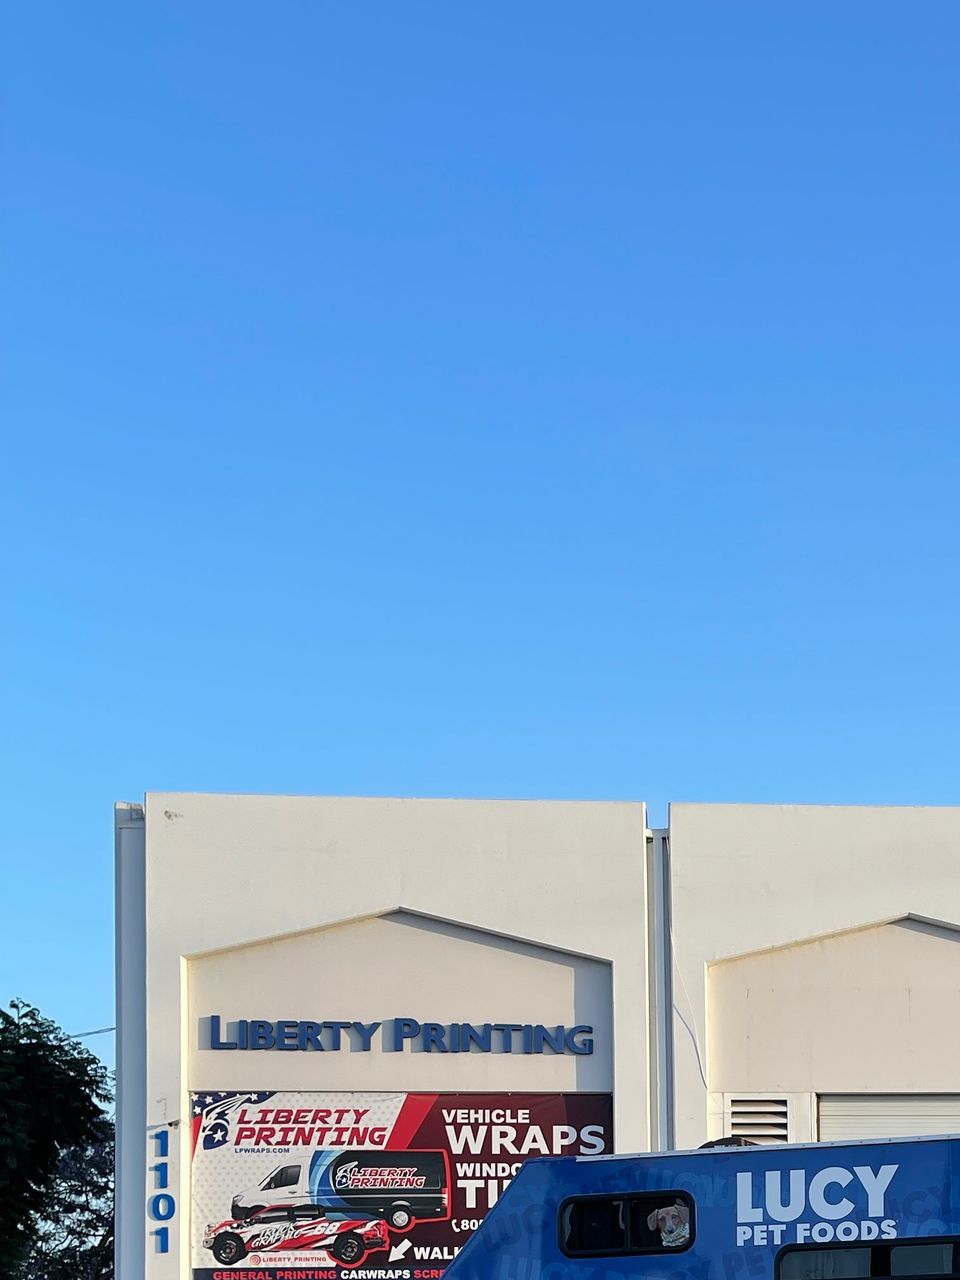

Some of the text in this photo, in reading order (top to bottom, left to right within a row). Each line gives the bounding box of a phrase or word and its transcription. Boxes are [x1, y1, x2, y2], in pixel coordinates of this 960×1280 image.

[211, 1015, 593, 1055] LIBERTY PRINTING
[237, 1109, 369, 1124] LIBERTY
[442, 1109, 529, 1123] VEHICLE
[234, 1127, 387, 1146] PRINTING
[445, 1125, 605, 1155] WRAPS
[351, 1168, 417, 1177] LIBERTY
[349, 1177, 426, 1188] PRINTING
[149, 1130, 176, 1253] 1101
[737, 1164, 899, 1223] LUCY
[313, 1223, 340, 1234] 68
[737, 1220, 898, 1246] PET FOODS
[213, 1272, 272, 1280] GENERAL
[276, 1270, 336, 1279] PRINTING
[341, 1270, 410, 1279] CARWRAPS
